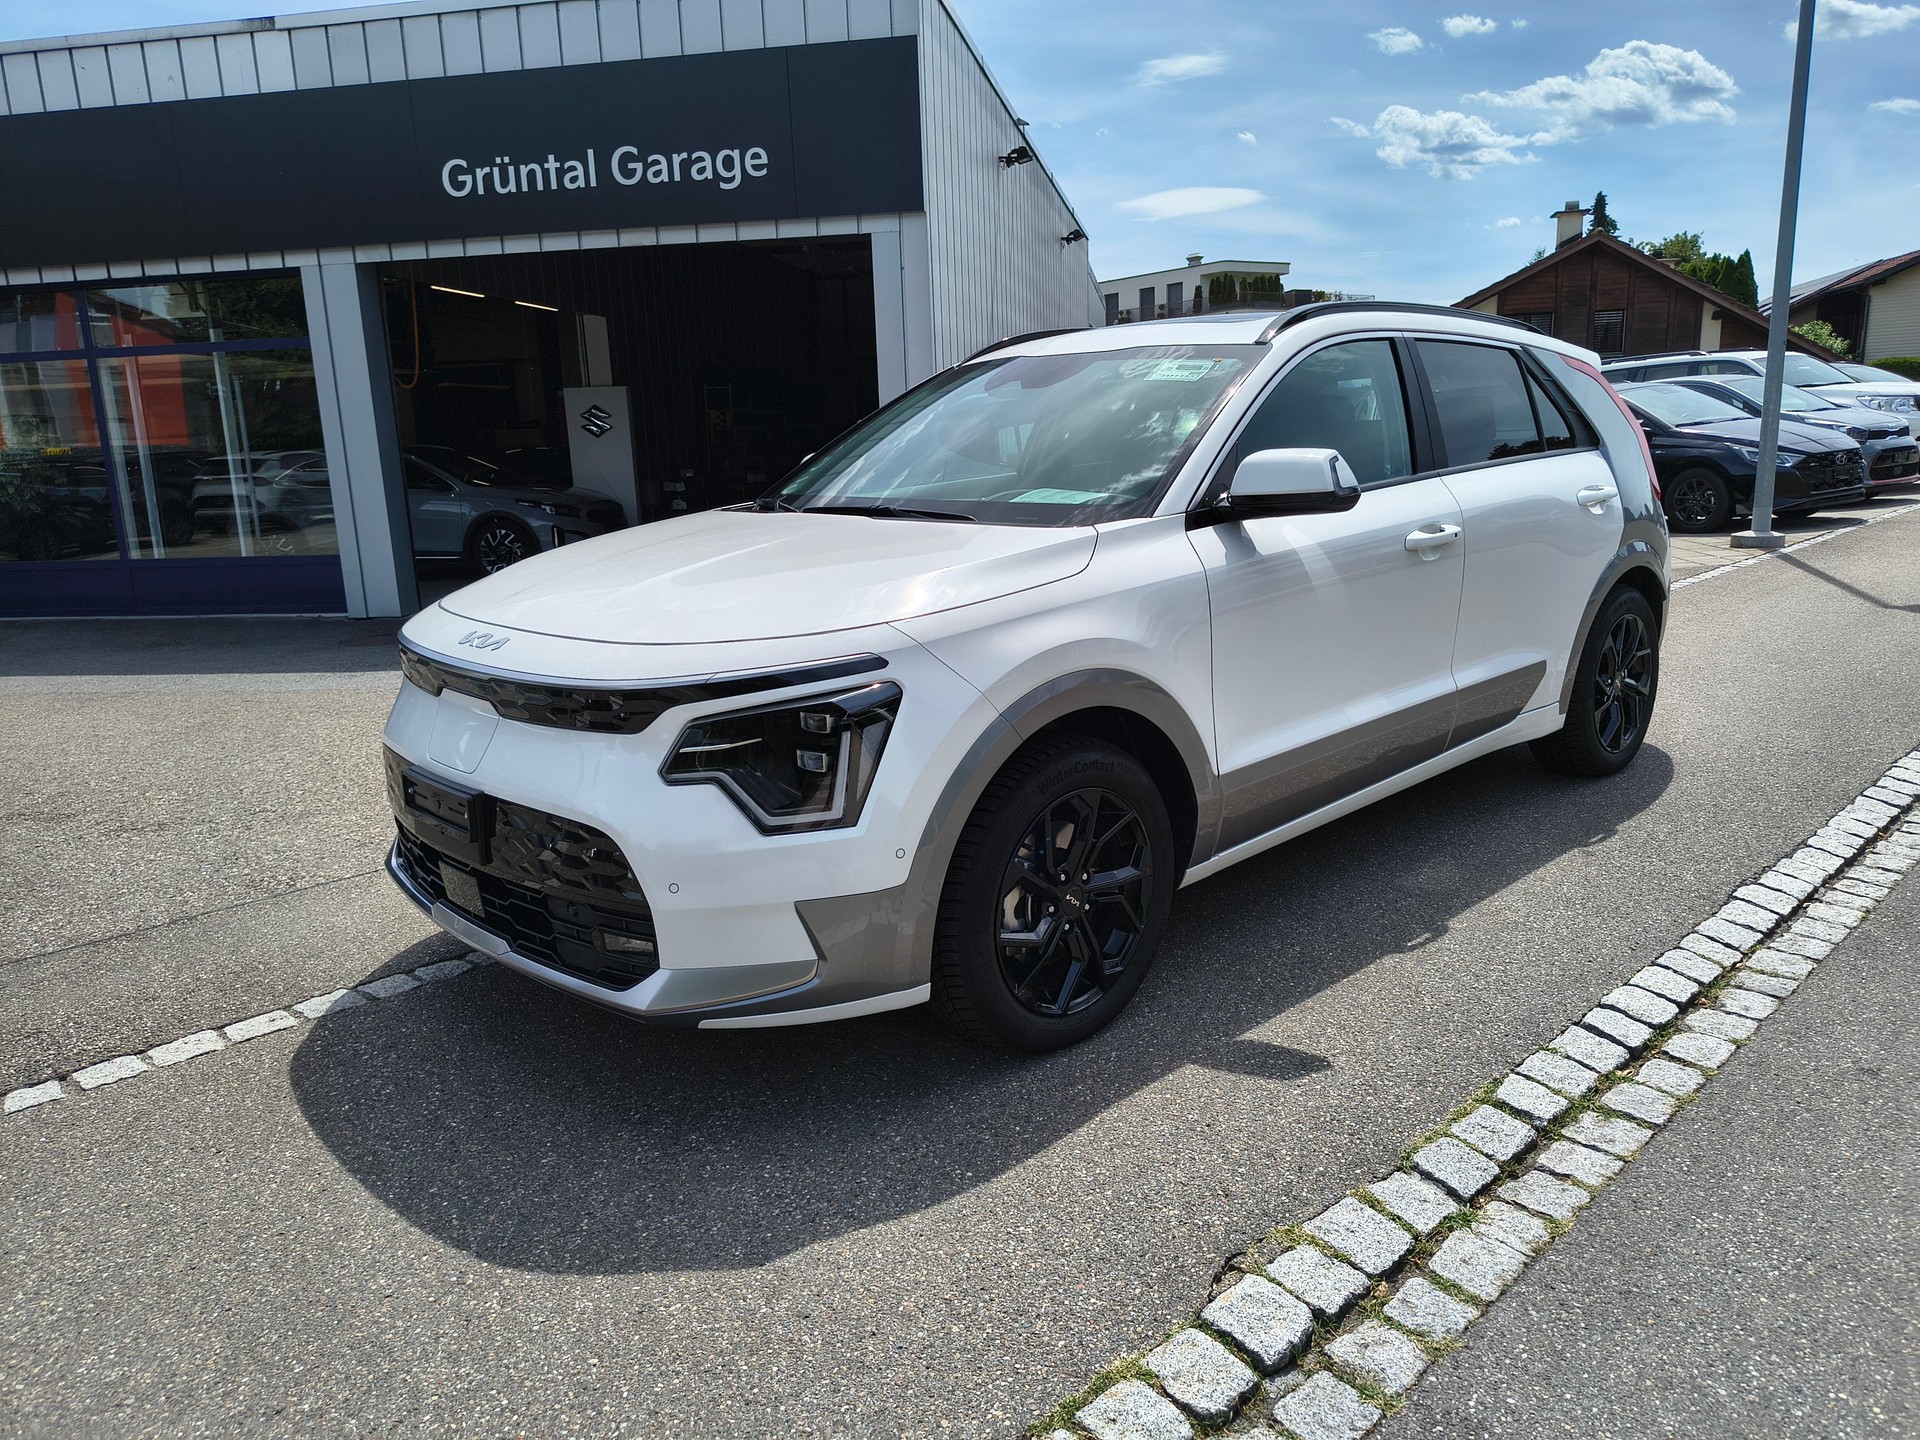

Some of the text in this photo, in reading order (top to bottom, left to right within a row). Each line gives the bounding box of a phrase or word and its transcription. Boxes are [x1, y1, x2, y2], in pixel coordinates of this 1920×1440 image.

[441, 145, 769, 198] Grüntal Garage
[1036, 759, 1116, 794] WinterContact
